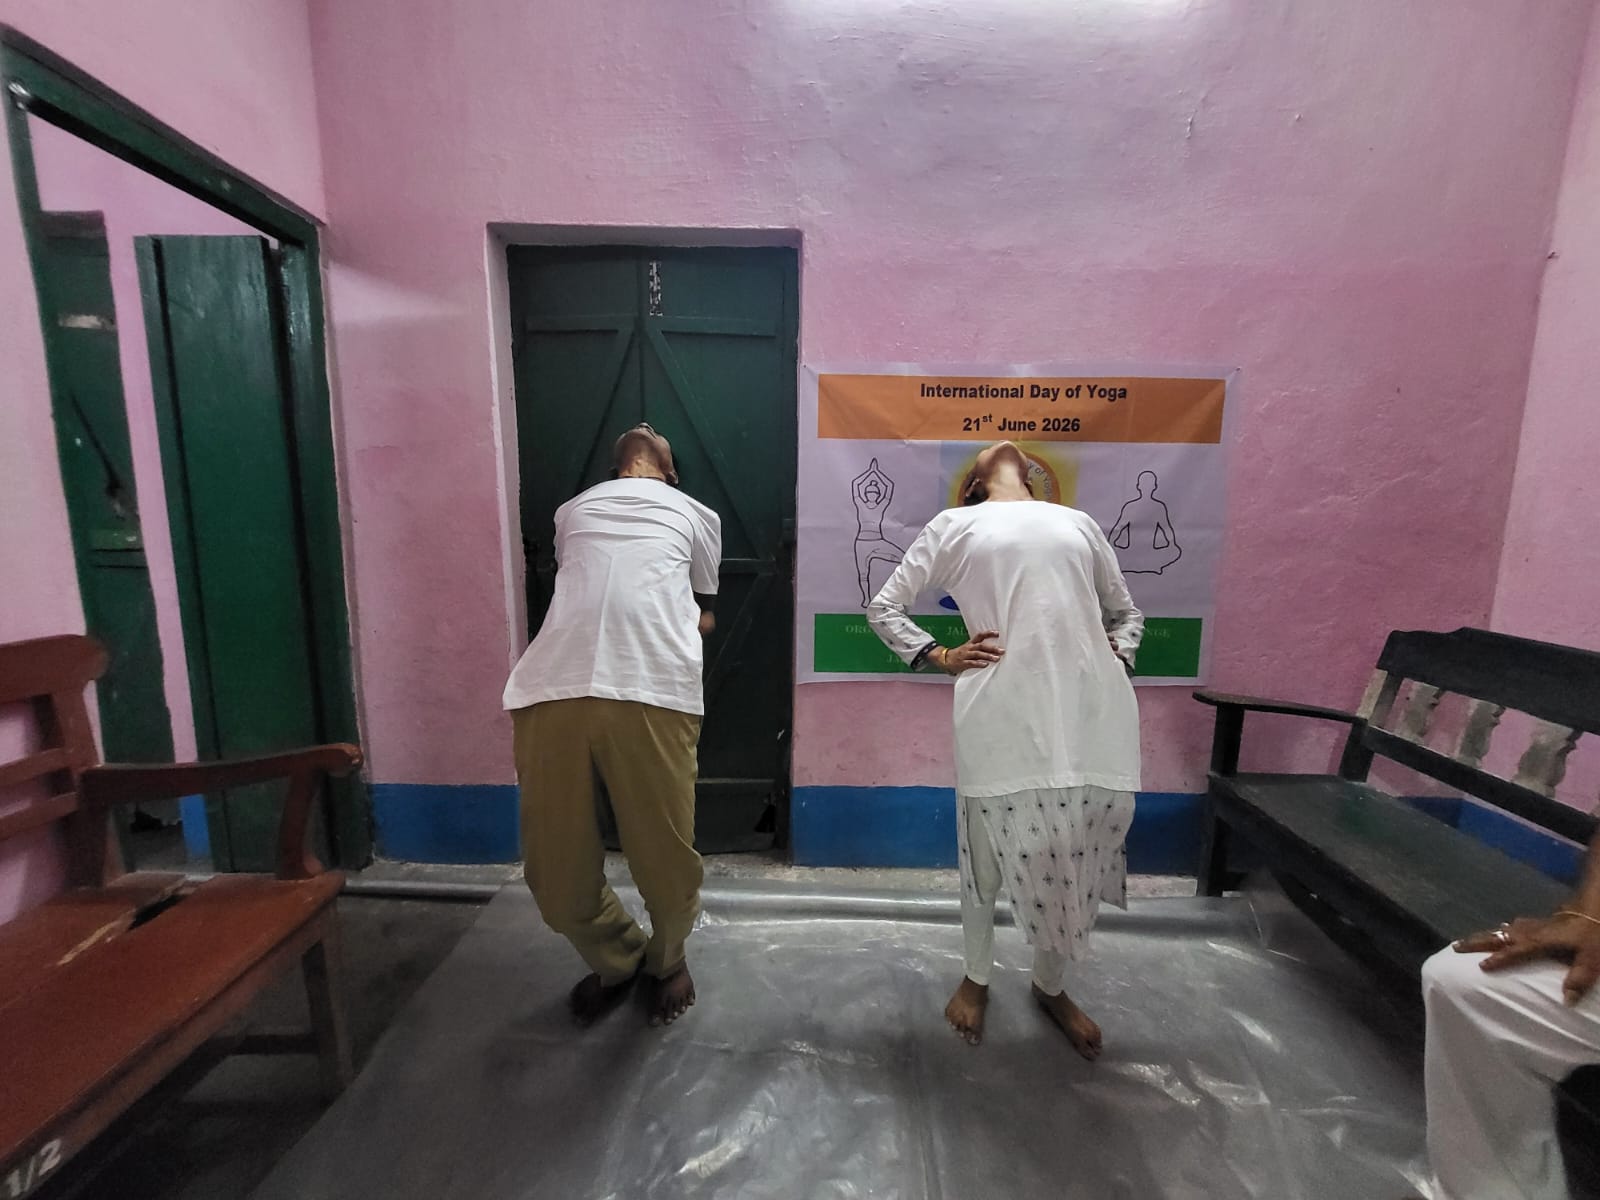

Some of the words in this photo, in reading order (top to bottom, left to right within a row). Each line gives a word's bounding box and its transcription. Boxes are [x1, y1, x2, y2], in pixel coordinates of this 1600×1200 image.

[920, 383, 1024, 398] International
[1030, 384, 1060, 401] Day
[1065, 384, 1081, 398] of
[1087, 385, 1127, 401] Yoga
[963, 413, 993, 431] 21st
[998, 417, 1036, 431] June
[1042, 417, 1080, 431] 2026
[5, 1138, 61, 1197] 1/2
